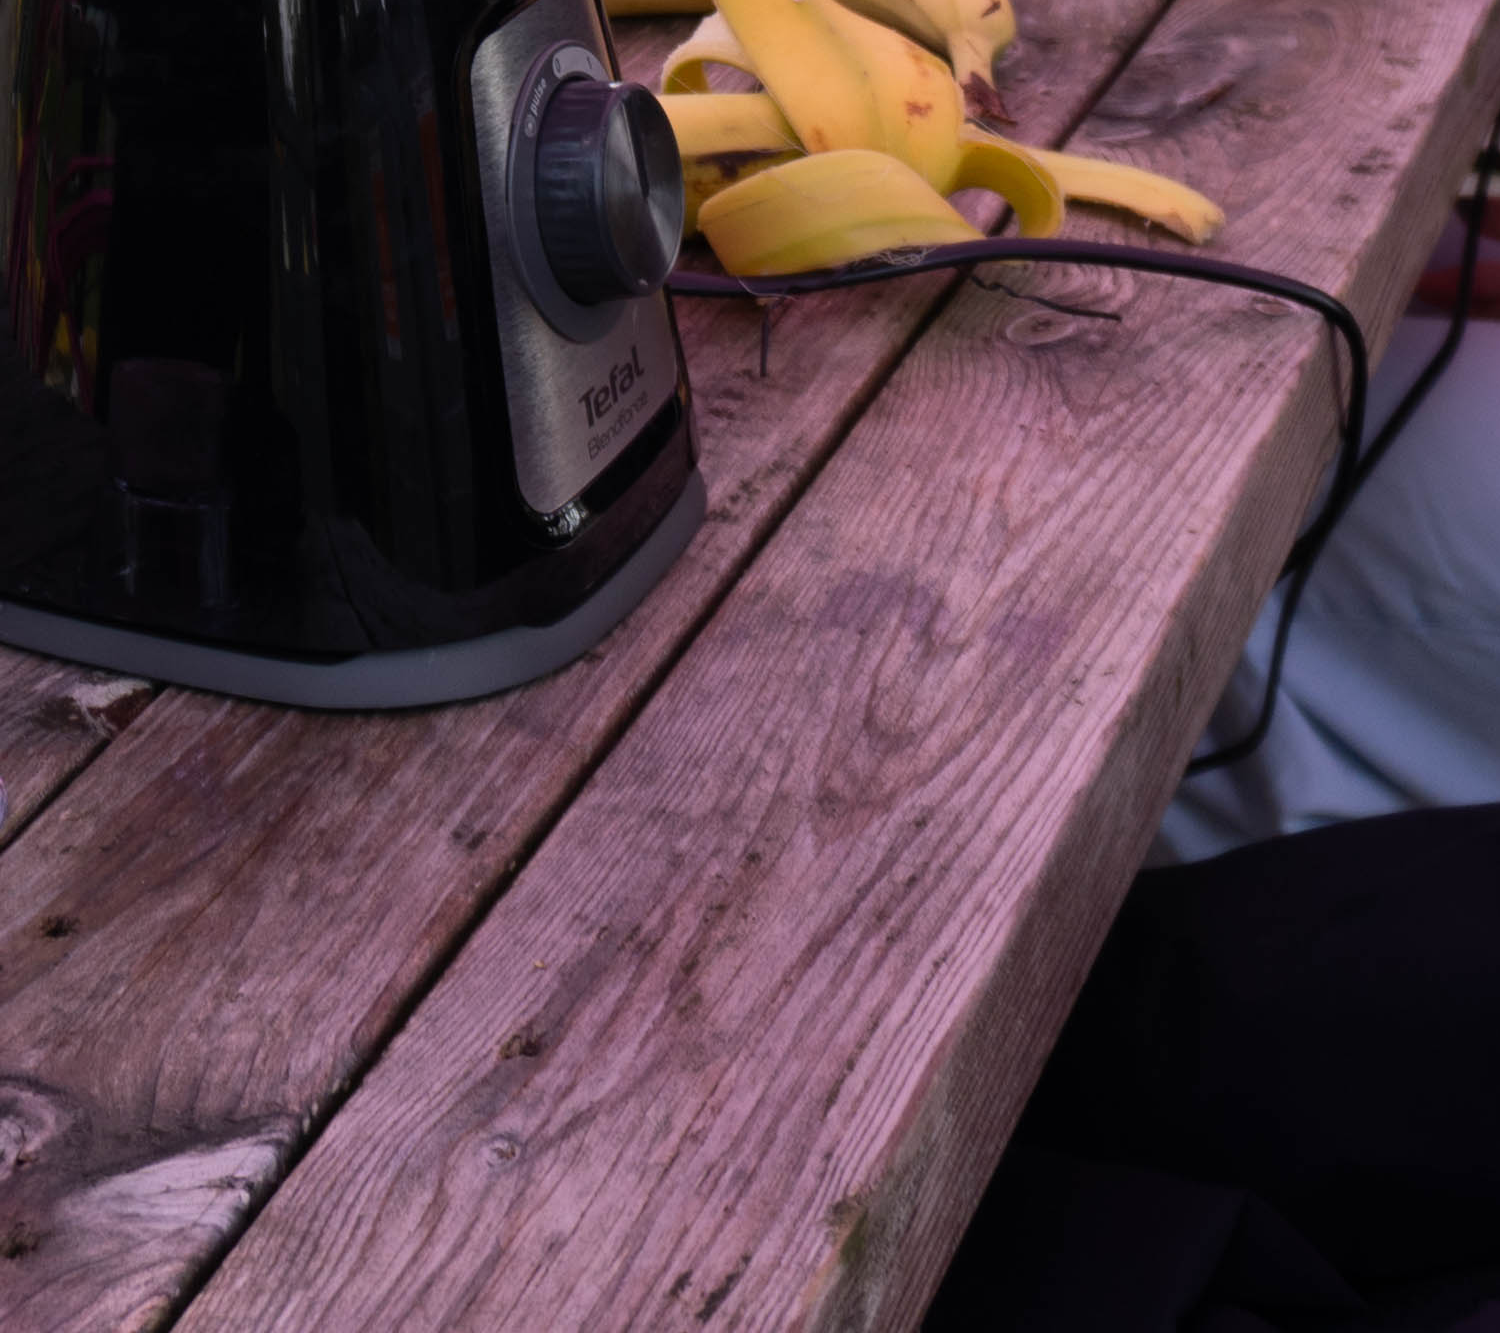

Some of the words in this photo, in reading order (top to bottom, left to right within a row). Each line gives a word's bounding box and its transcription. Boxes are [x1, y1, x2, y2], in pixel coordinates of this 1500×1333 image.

[529, 77, 547, 118] pulse
[577, 344, 646, 429] Tefal
[586, 389, 649, 461] Blendforce
